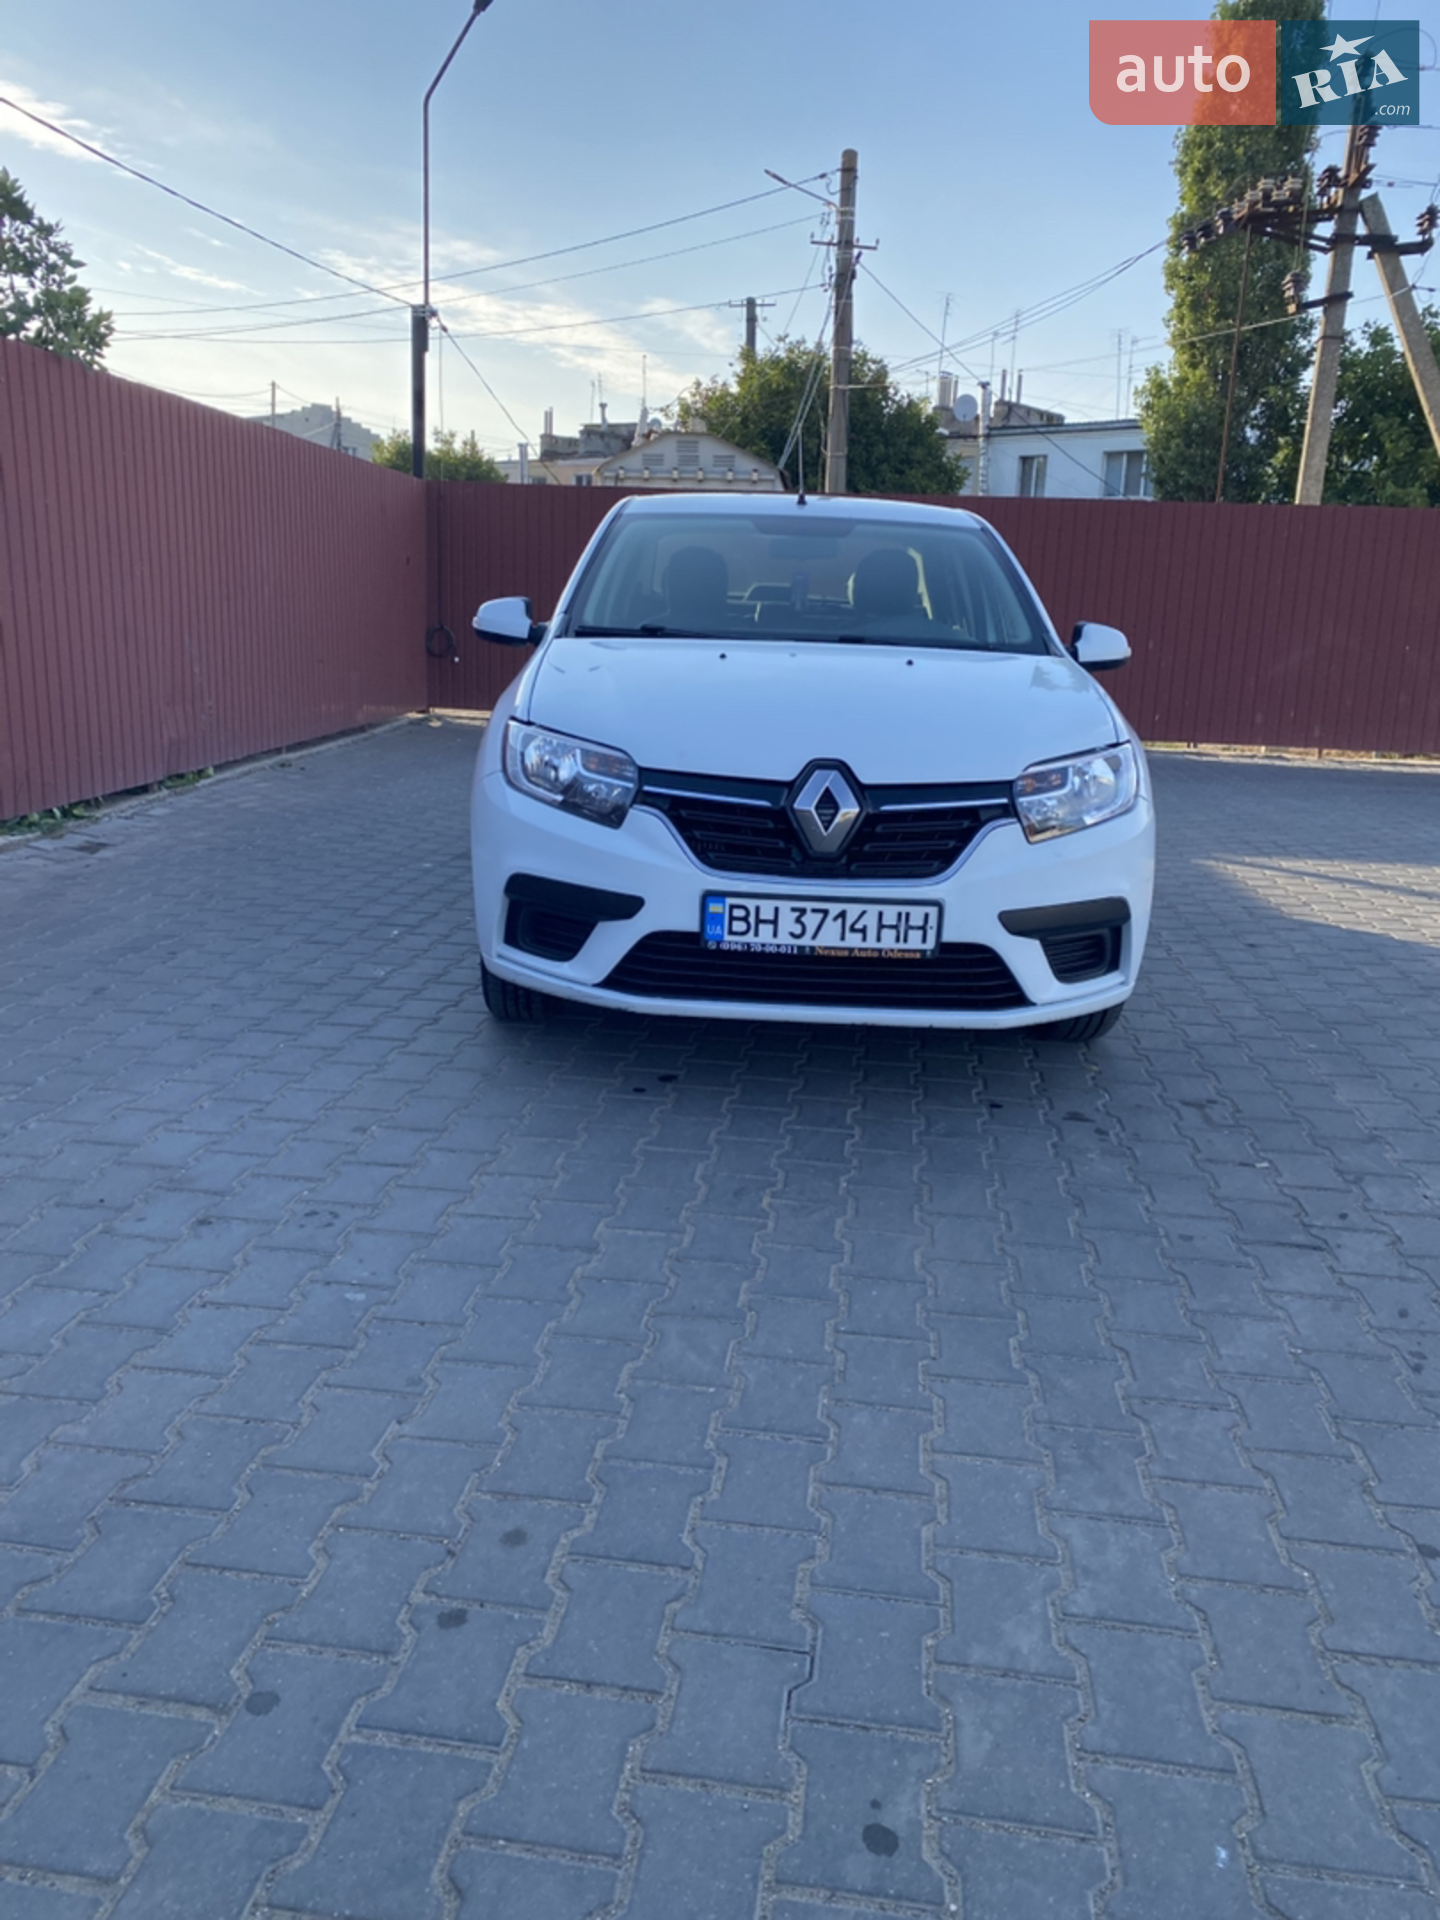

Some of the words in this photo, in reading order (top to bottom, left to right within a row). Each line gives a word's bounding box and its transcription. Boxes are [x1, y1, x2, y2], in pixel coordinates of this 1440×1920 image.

[727, 903, 779, 938] BH
[788, 906, 868, 942] 3714
[876, 909, 930, 944] HH
[707, 924, 723, 936] UA
[851, 948, 879, 958] Auto
[881, 948, 922, 959] Odessa
